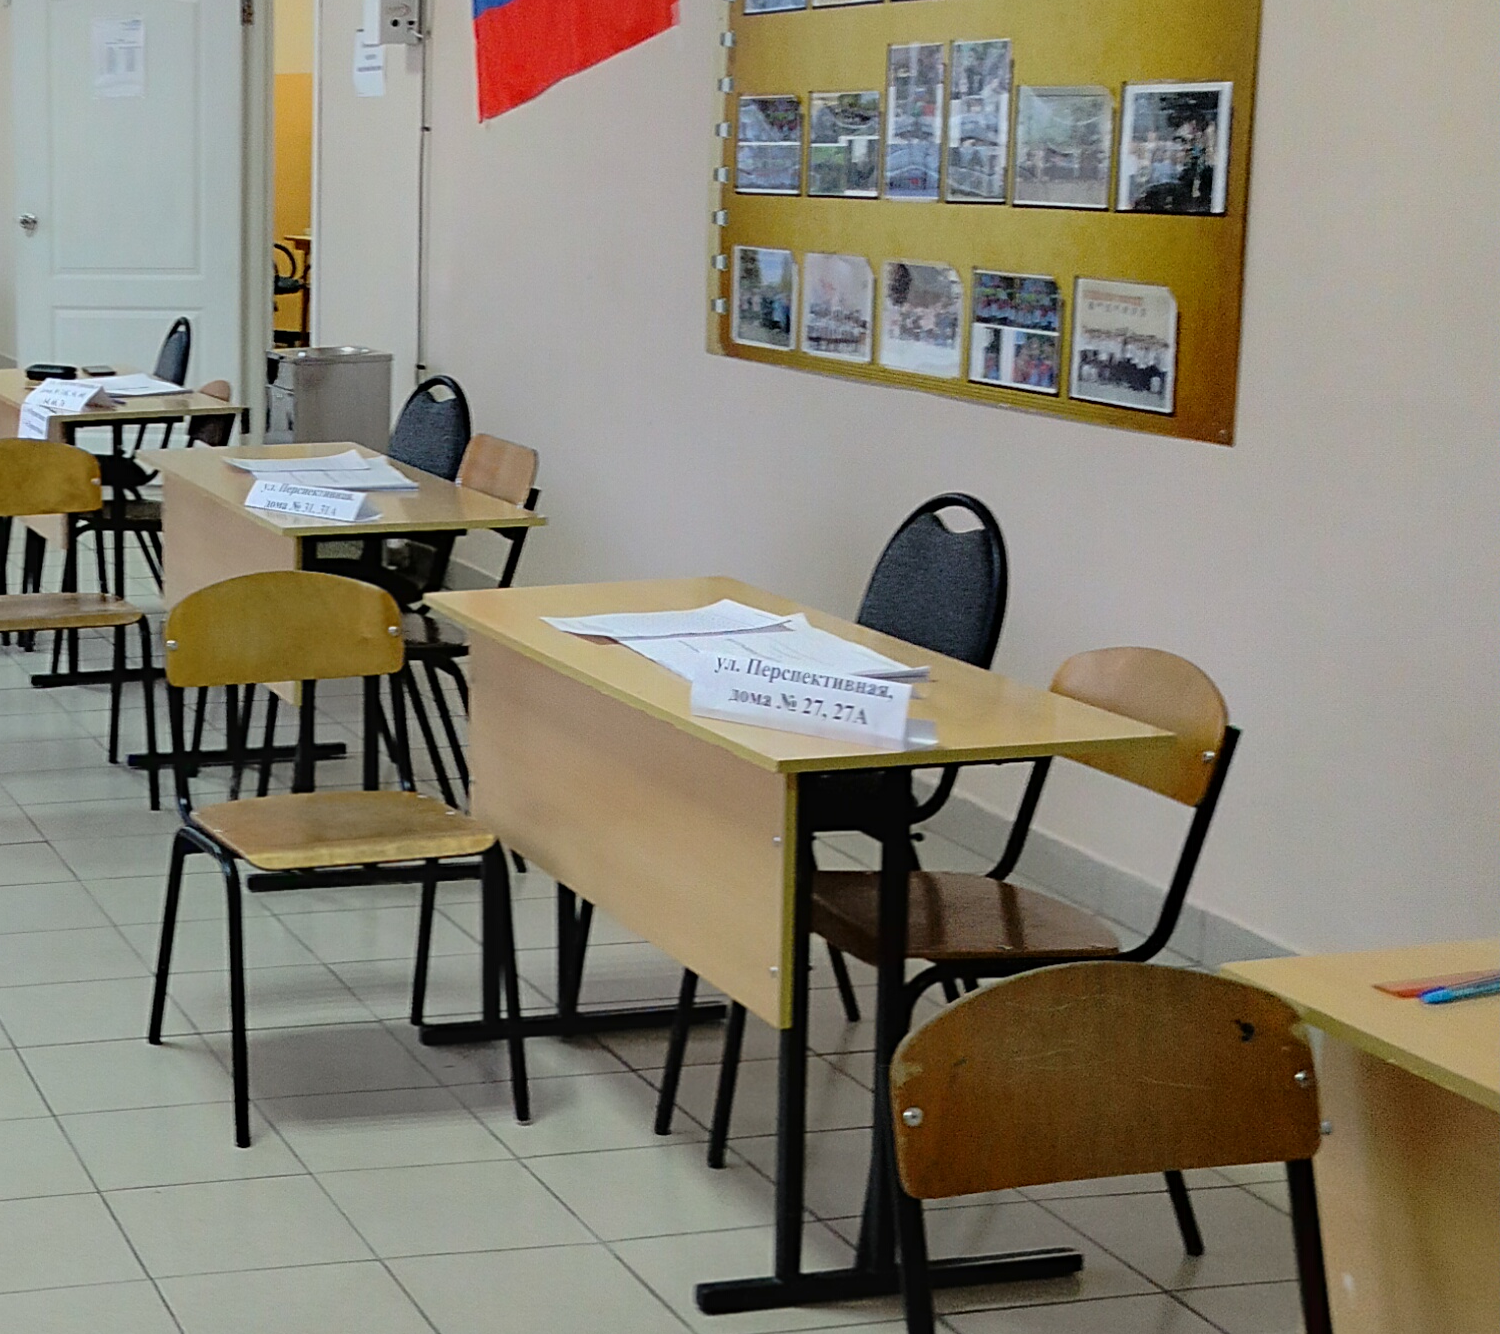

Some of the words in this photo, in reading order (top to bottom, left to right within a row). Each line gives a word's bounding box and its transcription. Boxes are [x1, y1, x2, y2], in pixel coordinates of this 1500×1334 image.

[714, 656, 740, 674] ул.
[746, 657, 894, 701] Перспективная,
[728, 688, 772, 707] дома
[775, 692, 797, 712] №
[802, 697, 828, 721] 27,
[832, 702, 868, 725] 27А
